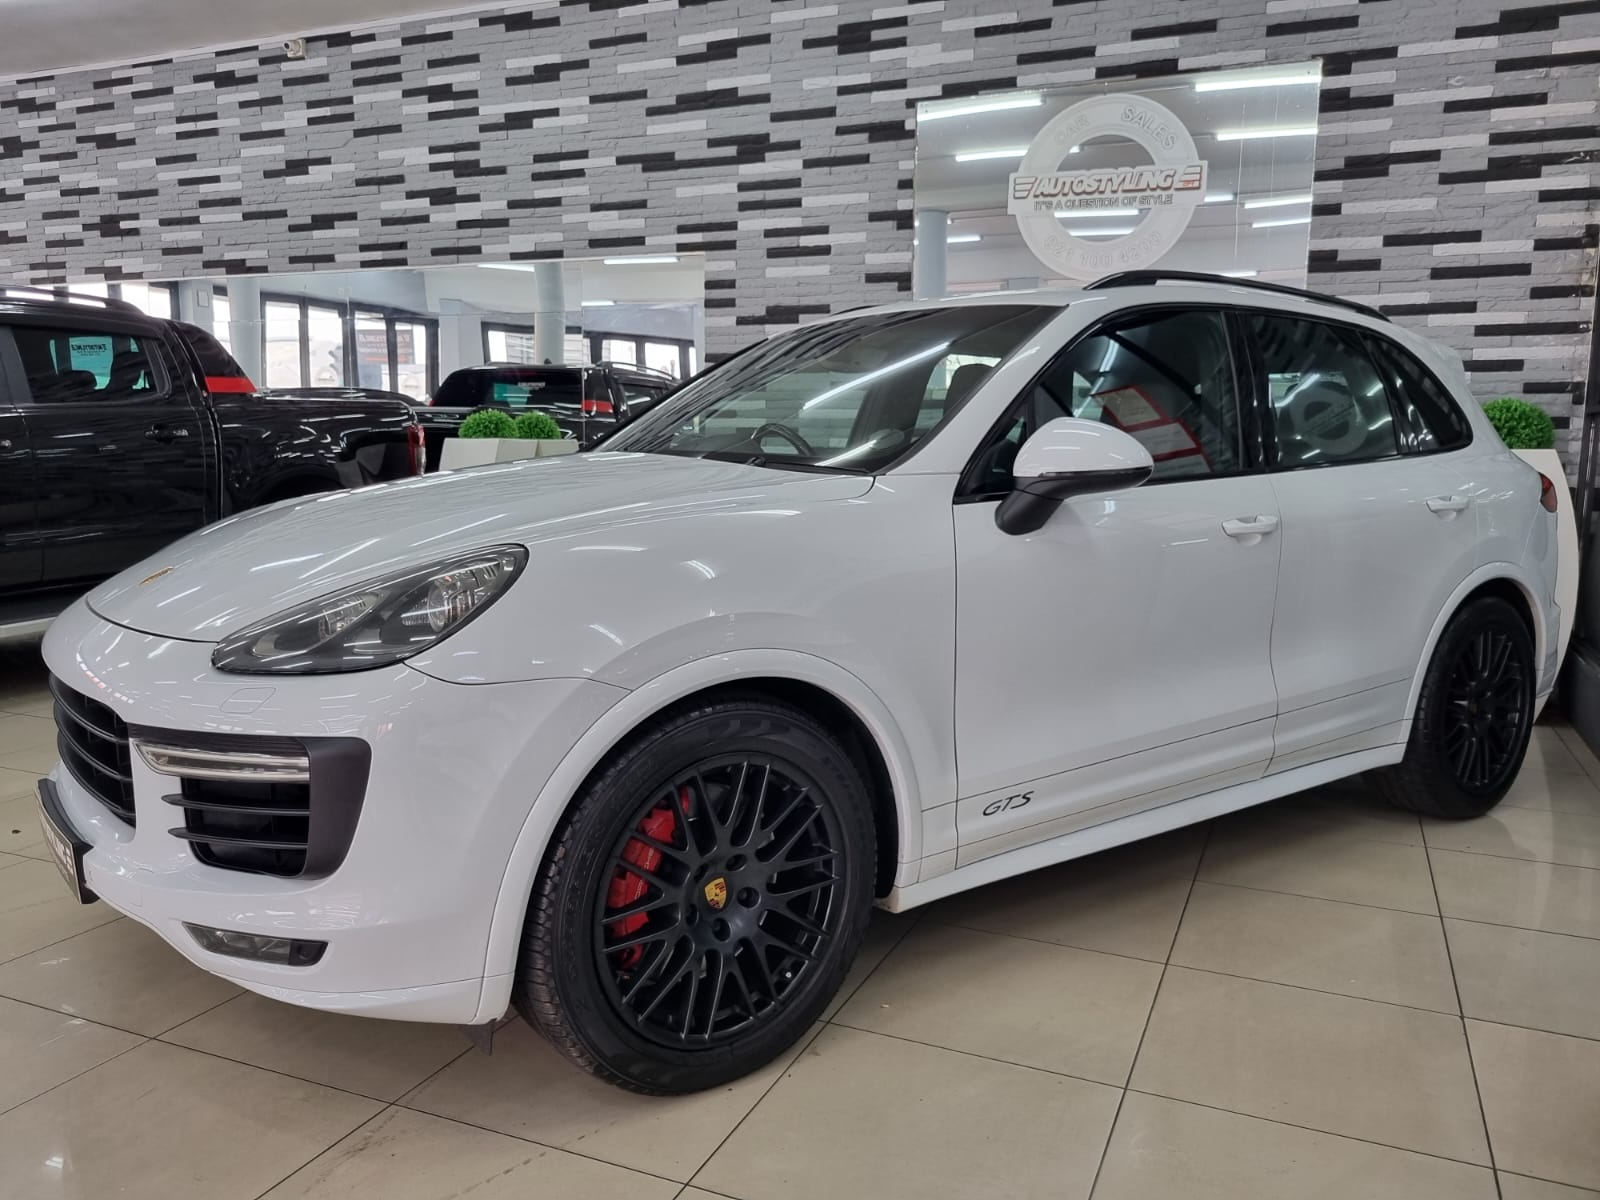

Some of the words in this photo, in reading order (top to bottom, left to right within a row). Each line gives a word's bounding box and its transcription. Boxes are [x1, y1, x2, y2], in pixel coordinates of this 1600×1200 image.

[1054, 113, 1090, 142] CAR
[1121, 104, 1177, 150] SALES
[1033, 169, 1176, 197] AUTOSTYLING
[1034, 200, 1053, 211] IT'S
[1054, 200, 1064, 209] A
[1064, 197, 1120, 209] QUESTION
[1122, 196, 1137, 207] OF
[1138, 193, 1174, 206] STYLE
[982, 790, 1035, 816] GTS
